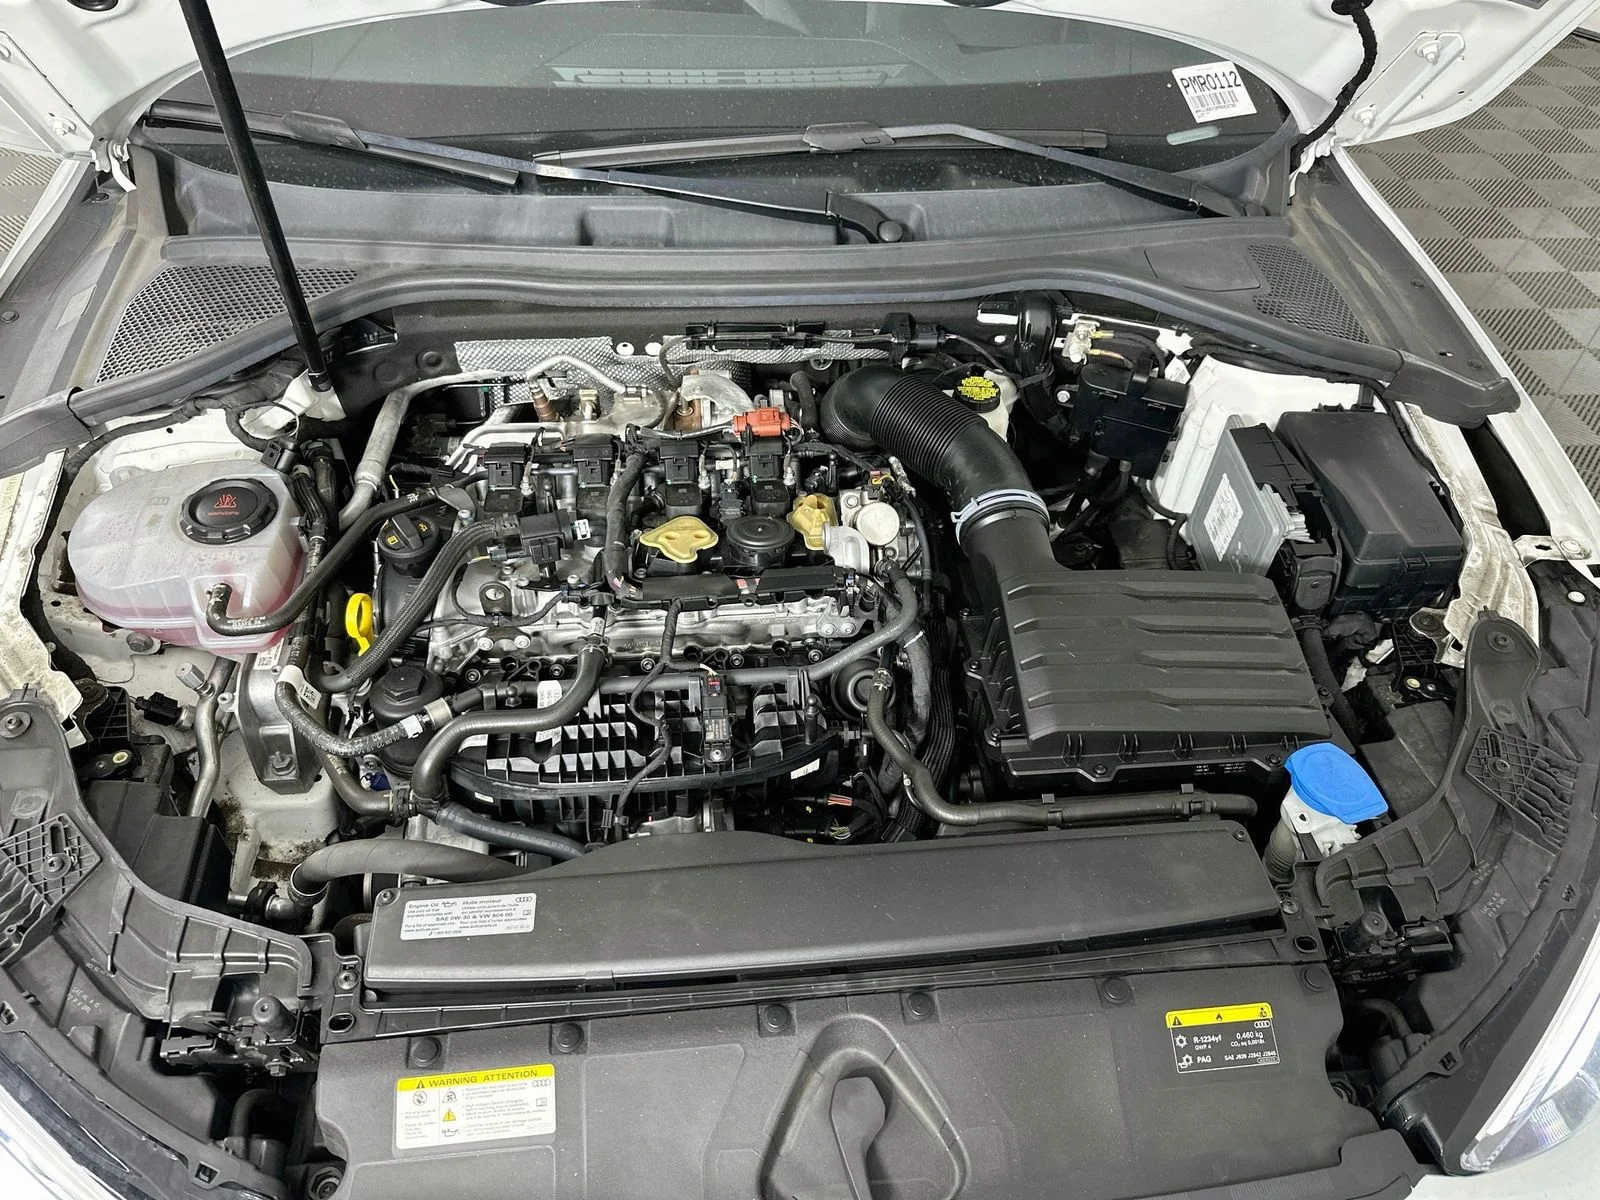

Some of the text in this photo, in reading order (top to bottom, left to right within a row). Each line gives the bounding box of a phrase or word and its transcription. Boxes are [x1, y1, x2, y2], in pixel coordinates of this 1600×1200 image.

[1180, 70, 1241, 95] PMR0112
[1194, 1034, 1222, 1044] R-1234yf
[1255, 1030, 1263, 1039] kg
[1197, 1055, 1212, 1064] PAG
[428, 1069, 538, 1087] WARNING ATTENTION
